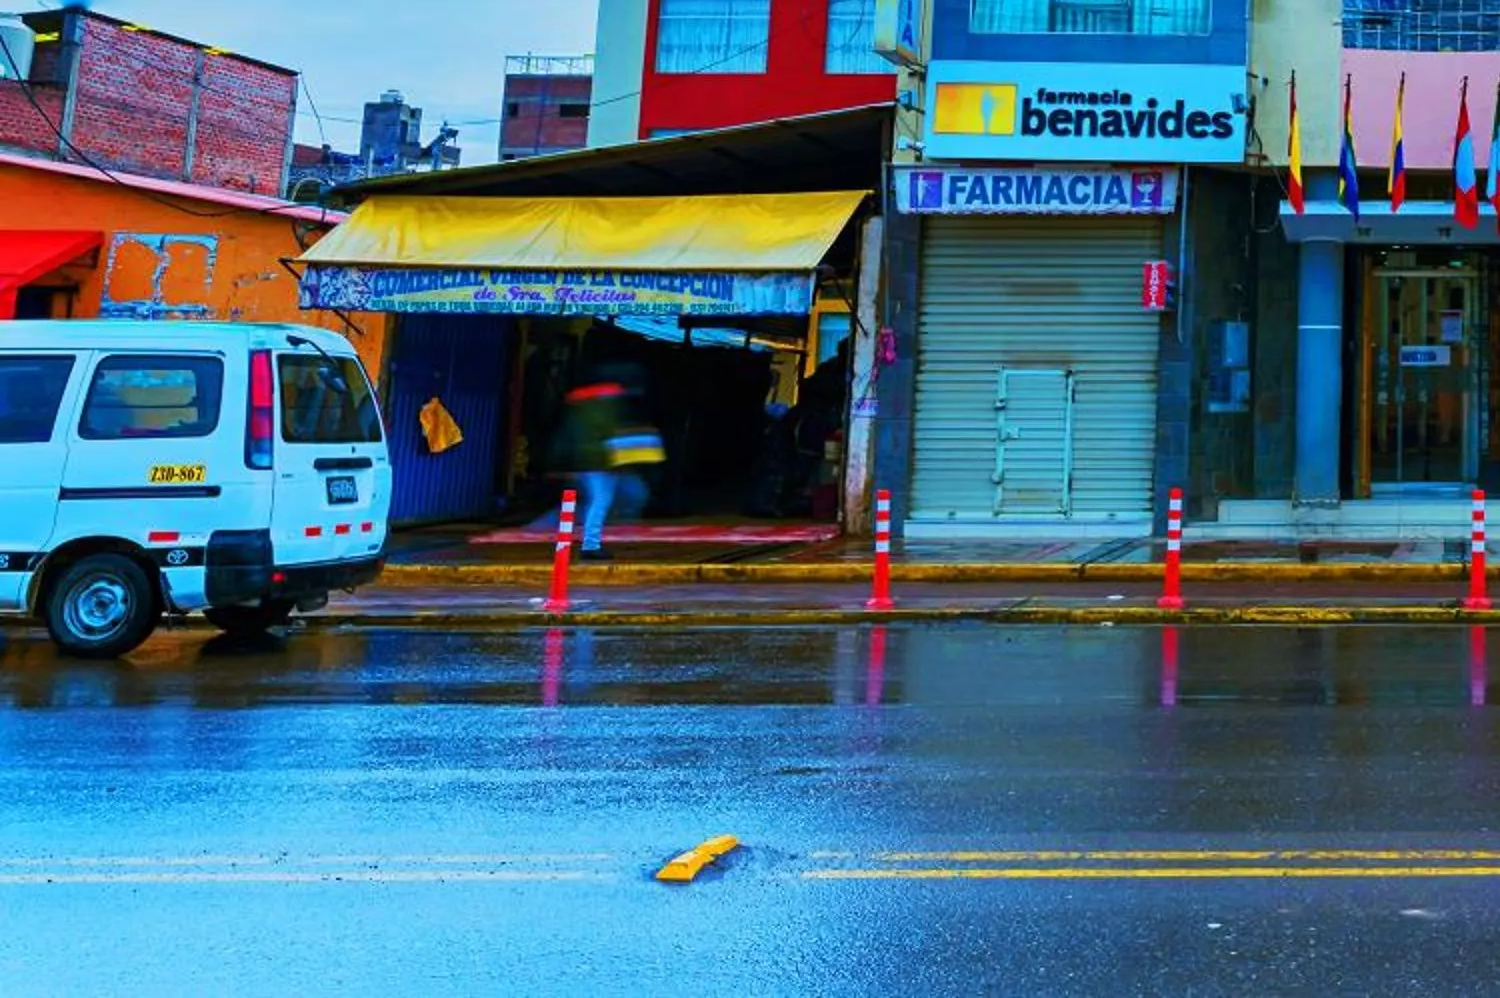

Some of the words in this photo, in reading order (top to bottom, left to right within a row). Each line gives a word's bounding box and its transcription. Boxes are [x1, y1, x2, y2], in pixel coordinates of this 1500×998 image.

[1037, 89, 1132, 104] farmacia
[1021, 99, 1233, 139] benavides
[948, 172, 1128, 206] FARMACIA
[372, 269, 484, 298] COMERCIAL
[563, 270, 584, 285] DE
[590, 270, 614, 286] LA
[473, 287, 496, 300] de
